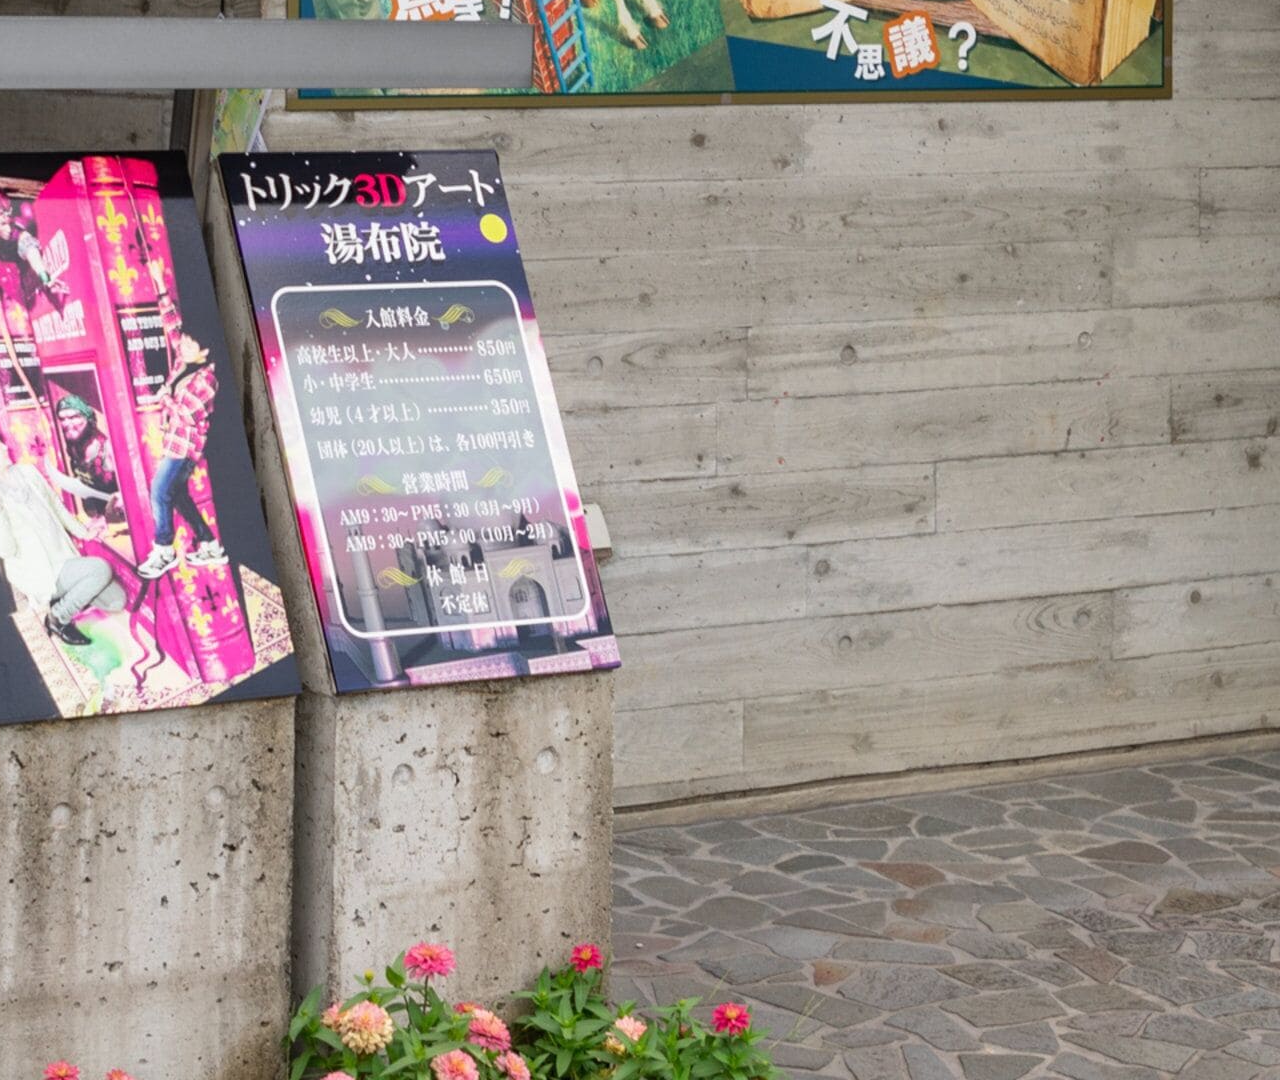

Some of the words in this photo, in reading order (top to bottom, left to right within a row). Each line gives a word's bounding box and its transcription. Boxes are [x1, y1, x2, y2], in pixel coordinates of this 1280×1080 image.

[239, 168, 496, 212] トリック3Dアート
[320, 221, 447, 266] 湯布院
[365, 306, 431, 330] 入館料金
[296, 342, 417, 365] 高校生以上・大人
[477, 339, 516, 358] 850円
[303, 371, 377, 395] 小・中学生
[483, 368, 523, 387] 650円
[490, 397, 530, 416] 350円
[401, 470, 470, 496] 営業時間
[426, 562, 490, 589] 休館日
[440, 592, 489, 615] 不定休
